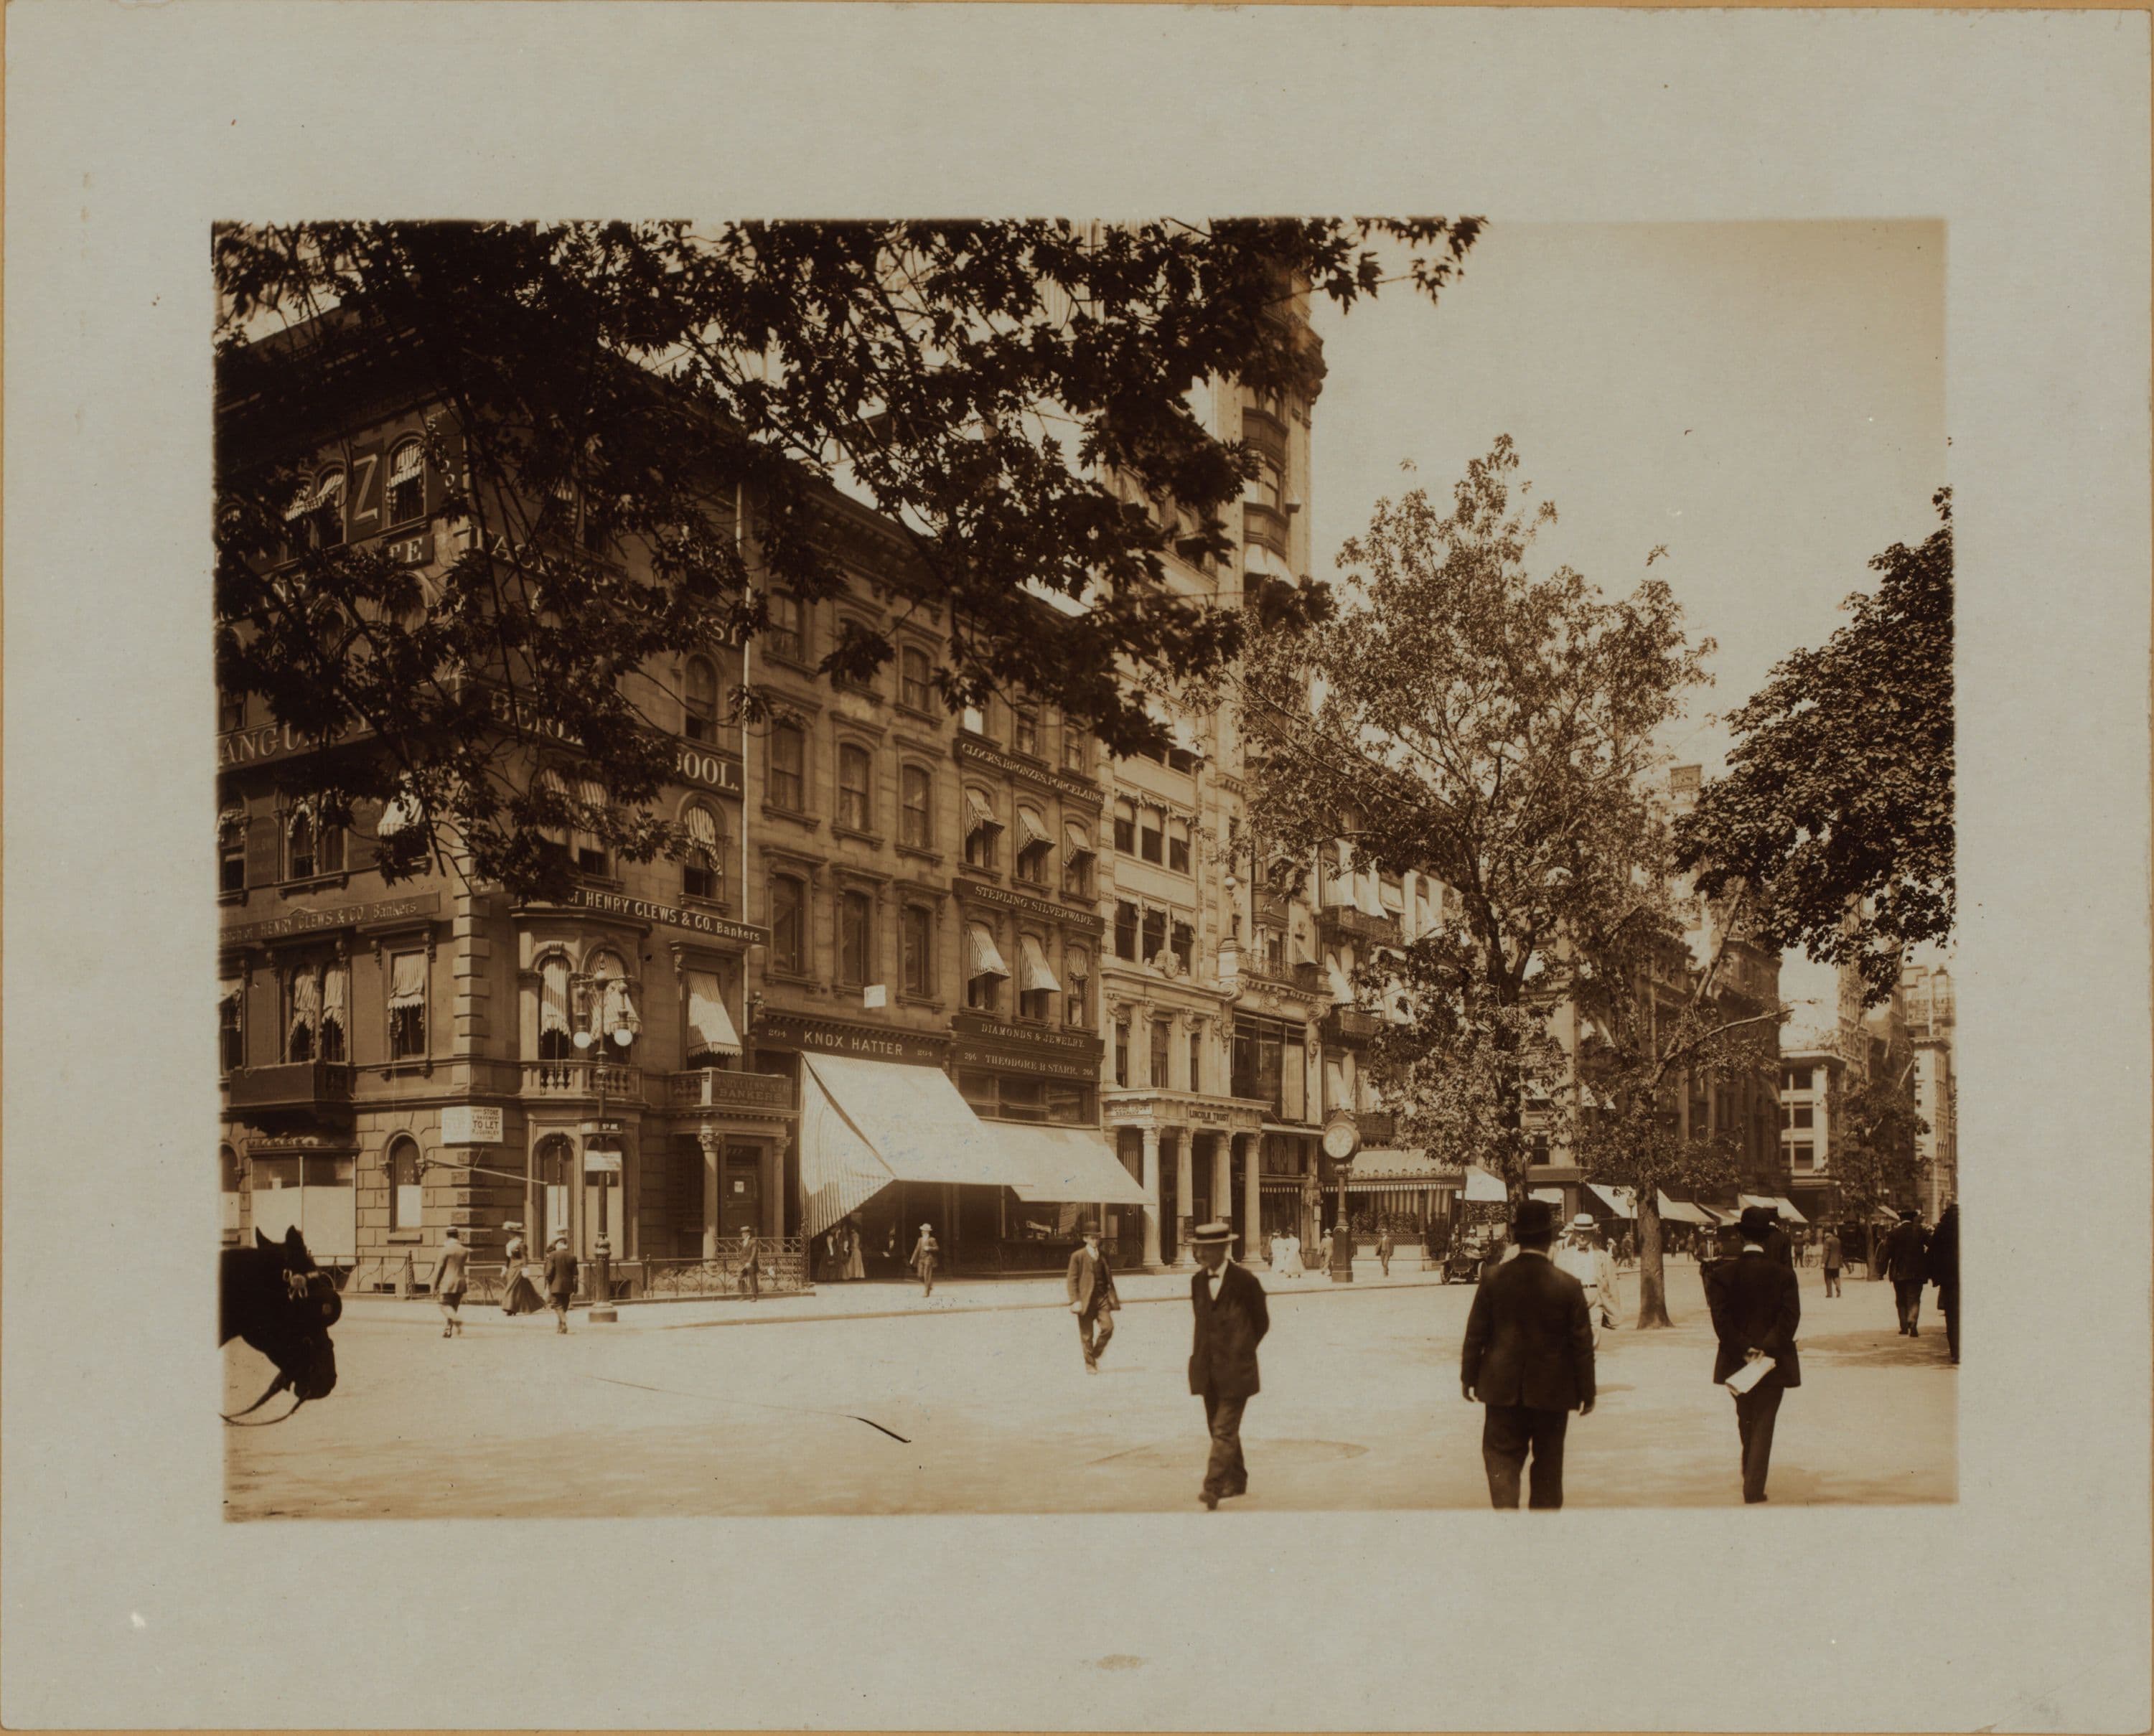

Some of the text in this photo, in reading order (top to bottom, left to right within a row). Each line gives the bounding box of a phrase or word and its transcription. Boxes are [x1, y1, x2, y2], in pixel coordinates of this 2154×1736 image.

[975, 886, 1027, 908] STERLING
[260, 917, 293, 937] HENRY
[298, 911, 333, 930] CLEWS
[337, 909, 345, 924] &
[373, 901, 418, 919] Bankers
[586, 891, 629, 914] HENRY
[635, 902, 677, 923] CLEWS
[680, 911, 690, 926] &
[694, 915, 713, 932] CO.
[716, 921, 761, 942] Bankers
[981, 1023, 1032, 1040] DIAMONDS
[1034, 1033, 1041, 1041] &
[767, 1028, 787, 1038] 204
[804, 1031, 843, 1048] KNOX
[851, 1037, 903, 1056] HATTER
[985, 1053, 1038, 1070] THEODORE
[718, 1087, 782, 1102] BANKERS
[473, 1120, 483, 1129] TO
[1212, 1112, 1230, 1122] TRUST
